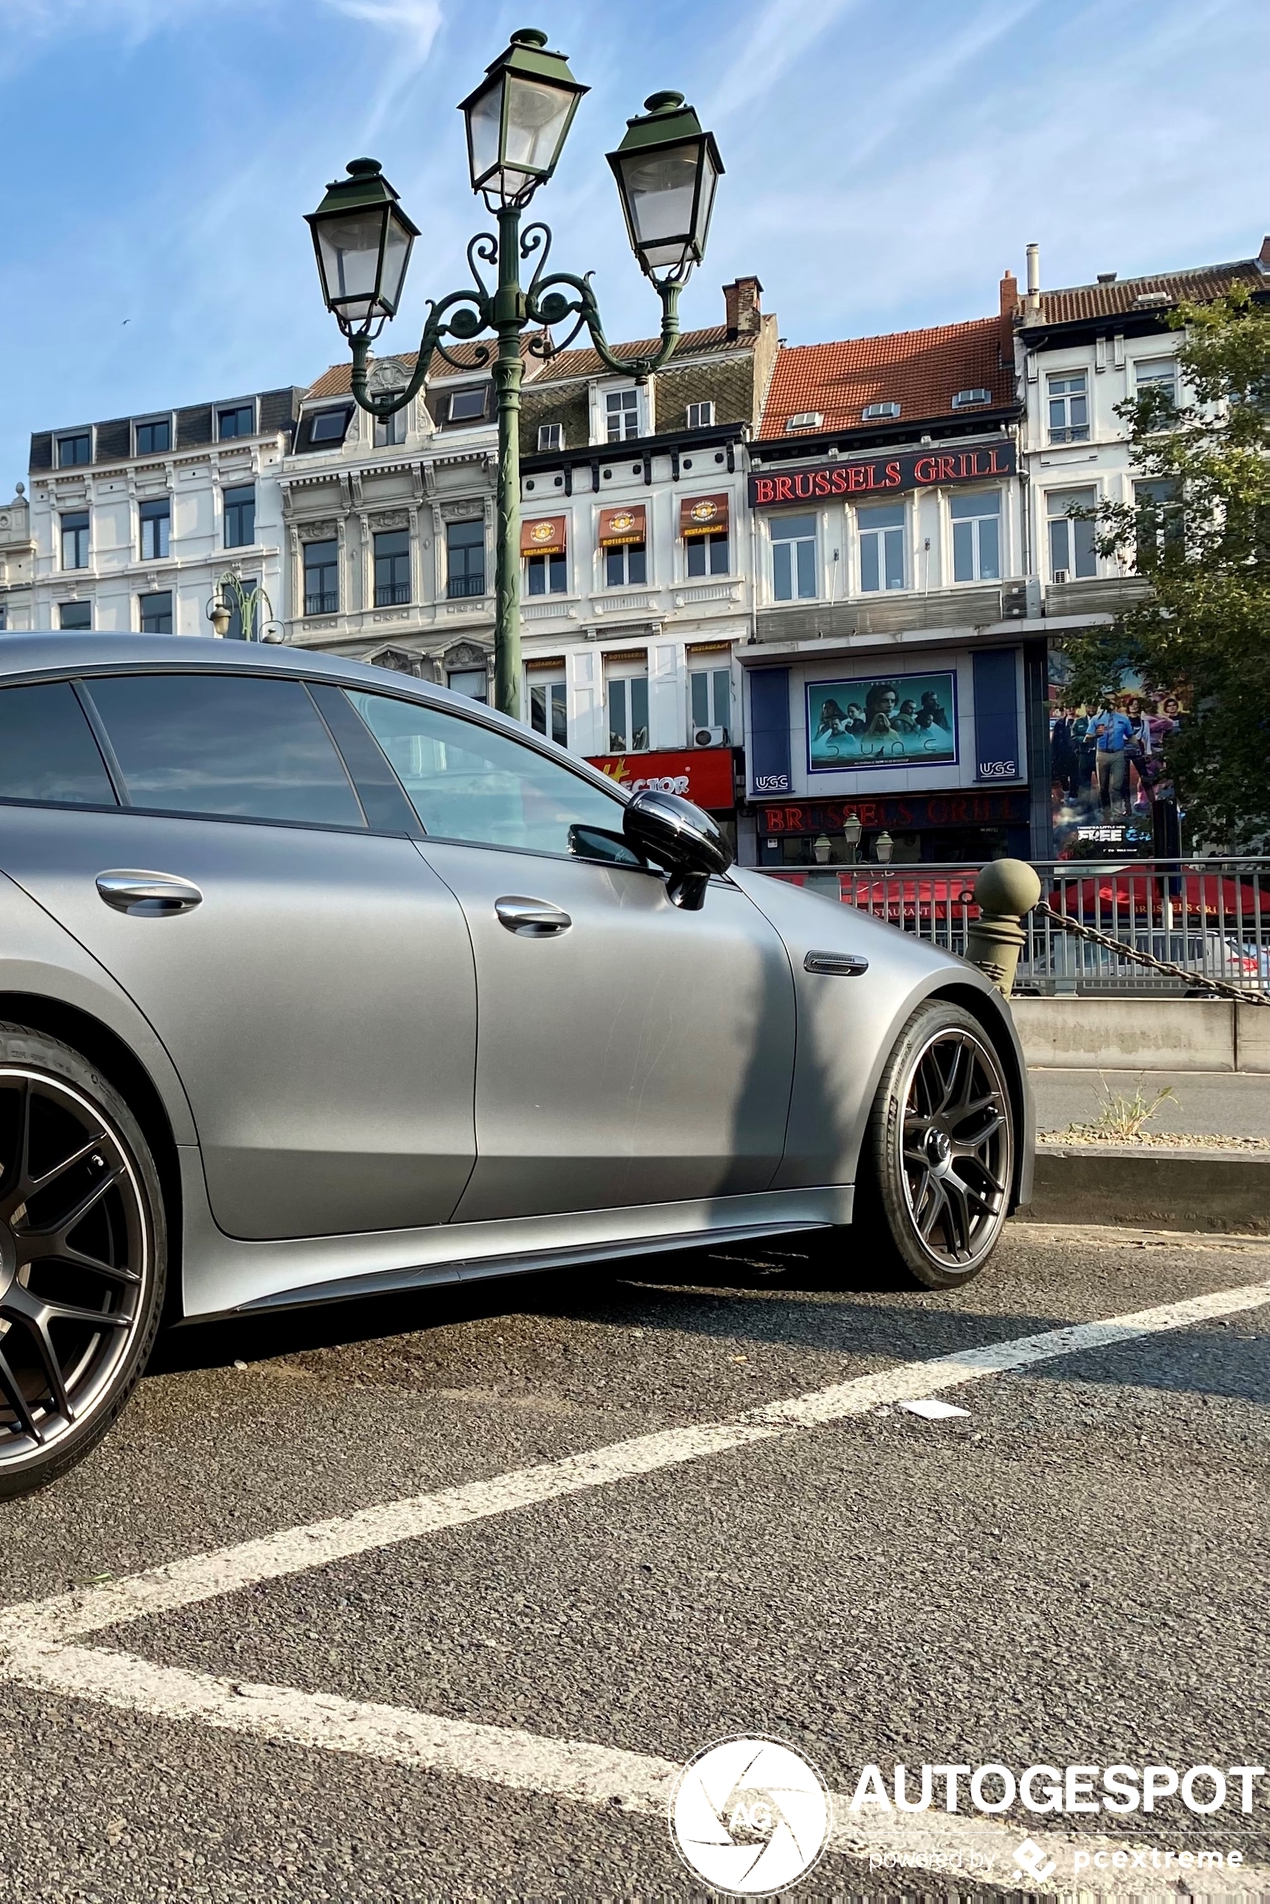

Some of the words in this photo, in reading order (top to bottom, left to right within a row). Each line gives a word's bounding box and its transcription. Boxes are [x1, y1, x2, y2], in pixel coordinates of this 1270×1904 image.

[755, 460, 903, 504] BRUSSELS
[913, 449, 1010, 484] GRILL
[602, 535, 641, 546] ROTISSERIE
[980, 760, 1016, 776] UGC
[756, 774, 789, 790] UGC
[1135, 902, 1192, 913] RSELS
[1196, 904, 1234, 914] GRIL
